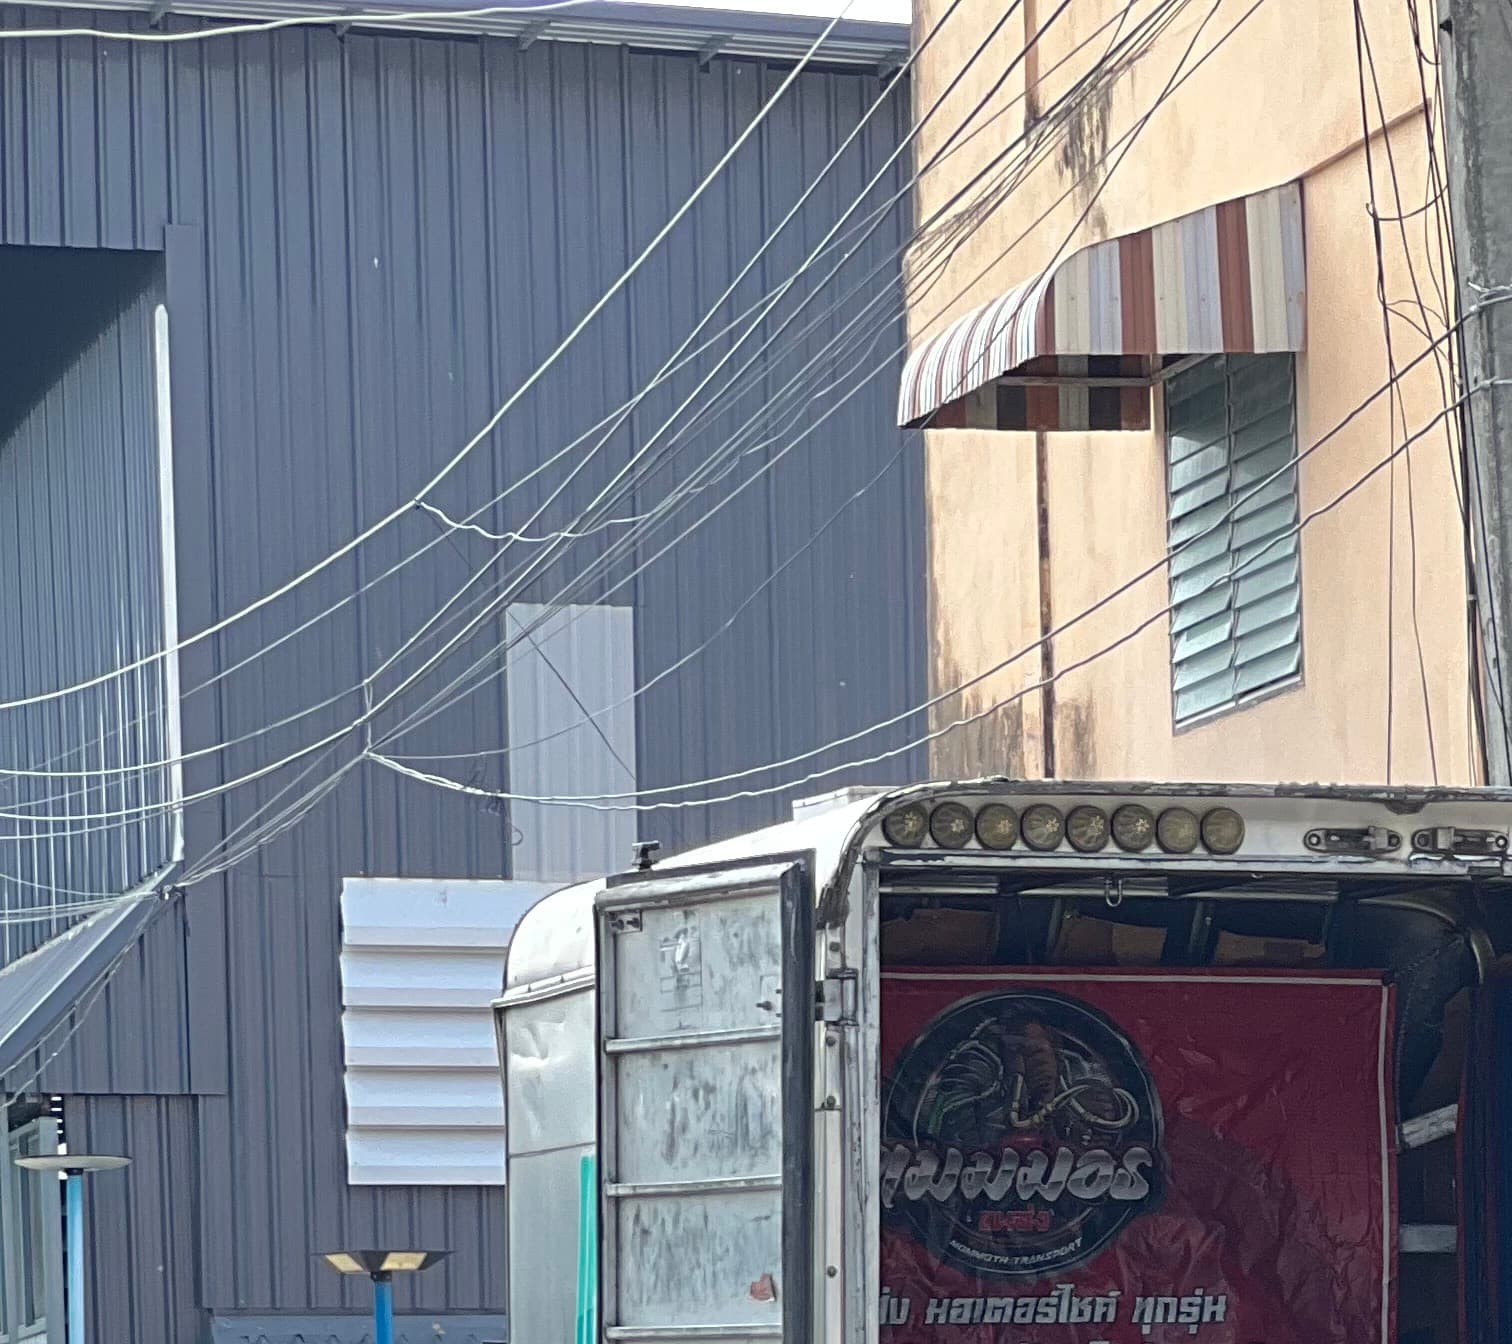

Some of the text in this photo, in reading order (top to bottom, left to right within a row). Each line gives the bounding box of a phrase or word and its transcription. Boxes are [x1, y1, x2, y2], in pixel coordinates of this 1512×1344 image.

[924, 1283, 1122, 1324] มอเตอร์ไซค์
[1131, 1287, 1227, 1335] ทุกรุ่น
